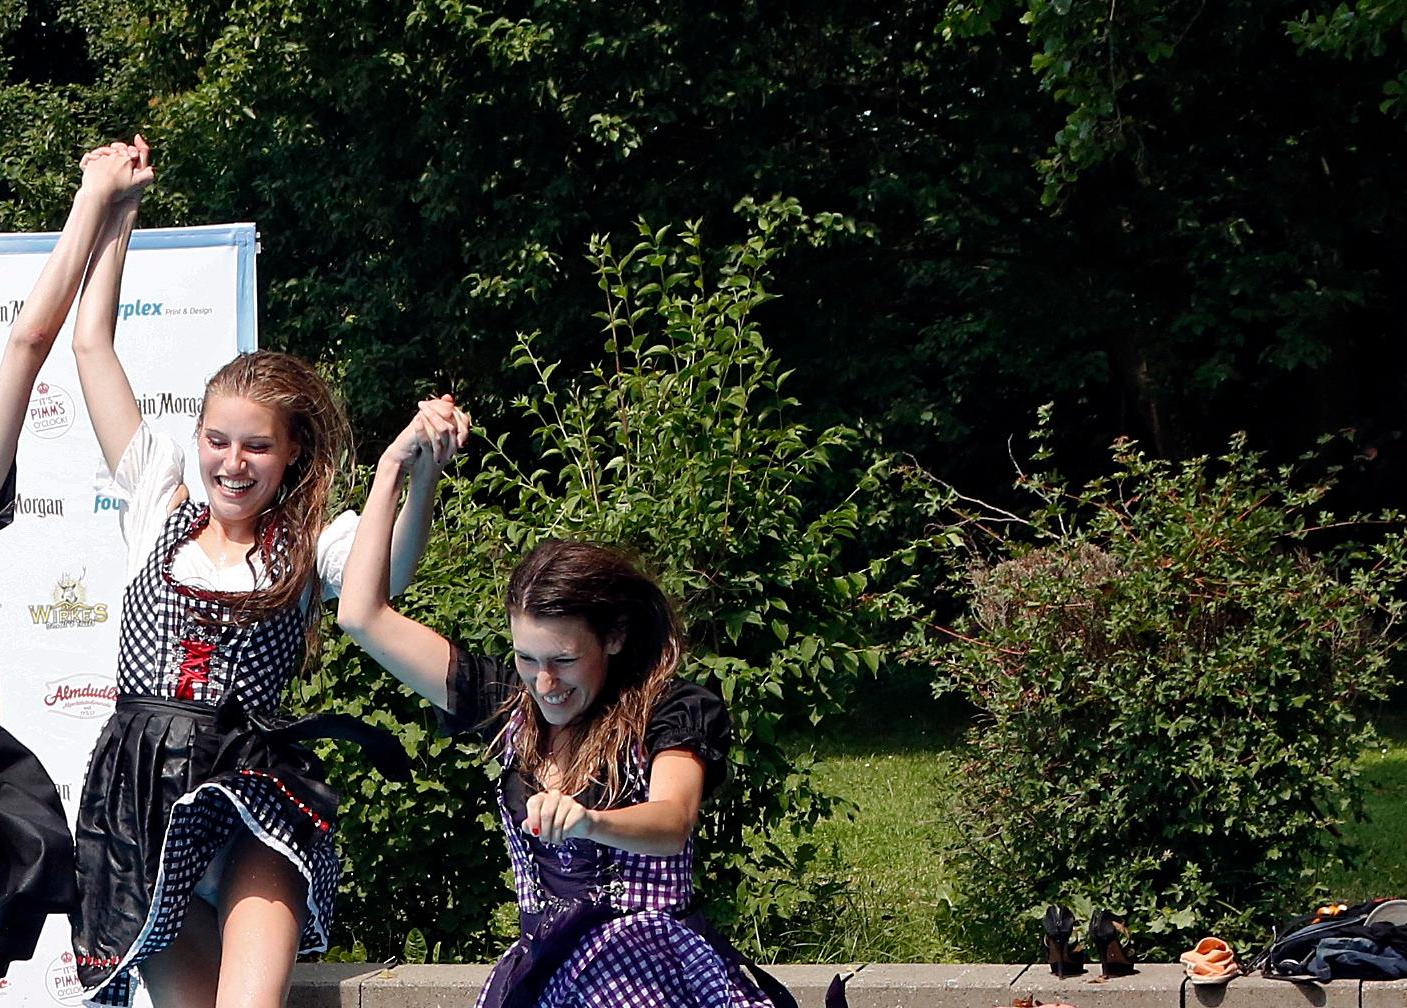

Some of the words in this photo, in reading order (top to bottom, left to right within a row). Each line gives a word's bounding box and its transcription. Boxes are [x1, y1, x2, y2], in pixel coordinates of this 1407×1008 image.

[117, 299, 163, 321] rplex
[190, 307, 213, 315] Design
[30, 401, 66, 420] PIMM'S
[155, 393, 203, 420] Morga
